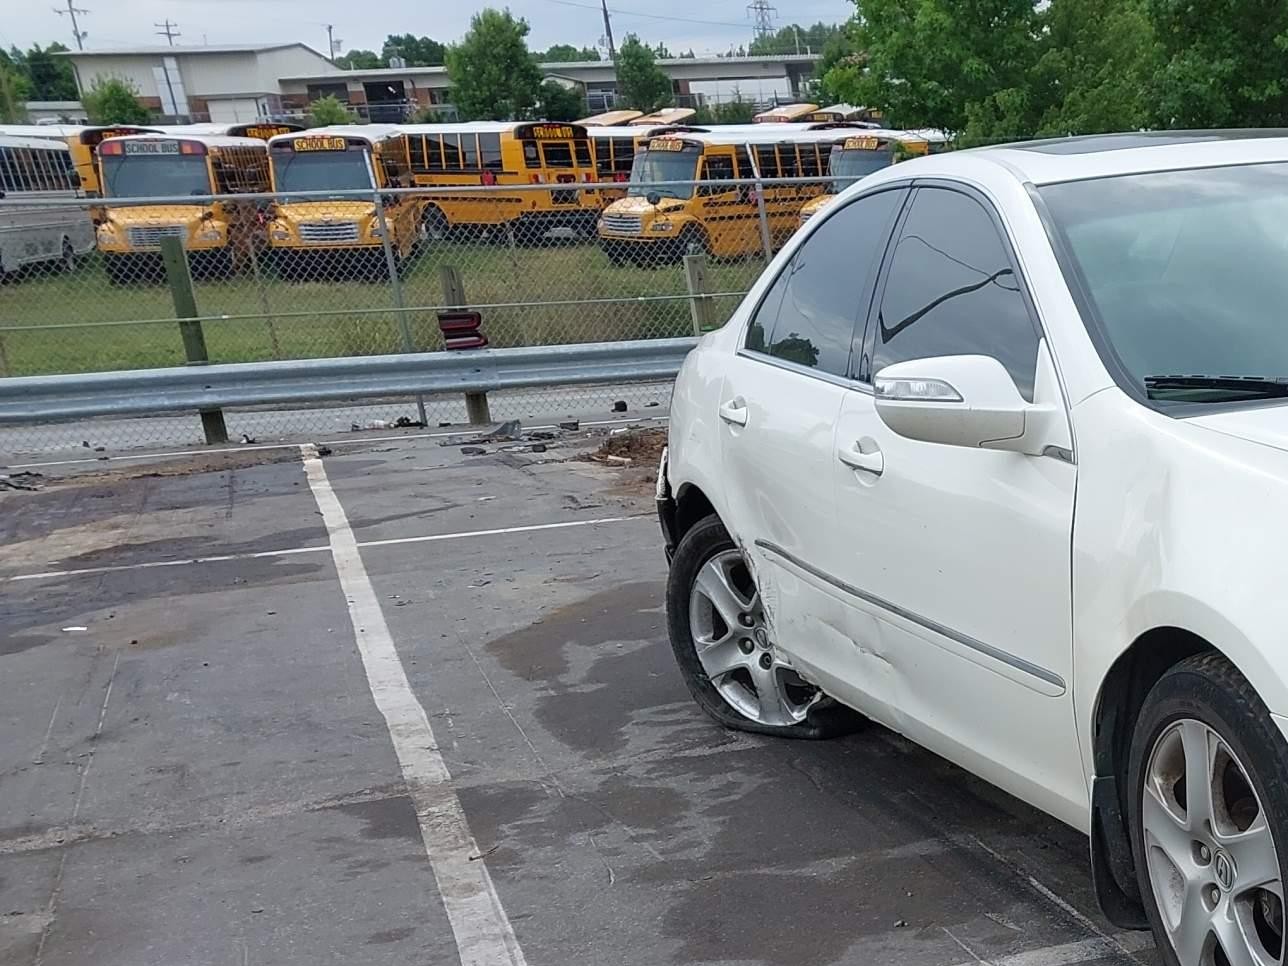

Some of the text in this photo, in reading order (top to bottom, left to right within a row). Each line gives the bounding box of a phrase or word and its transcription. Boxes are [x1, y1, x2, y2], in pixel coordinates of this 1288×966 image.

[126, 143, 178, 153] SCHOOL BUS
[295, 138, 344, 150] SCHOOL BUS
